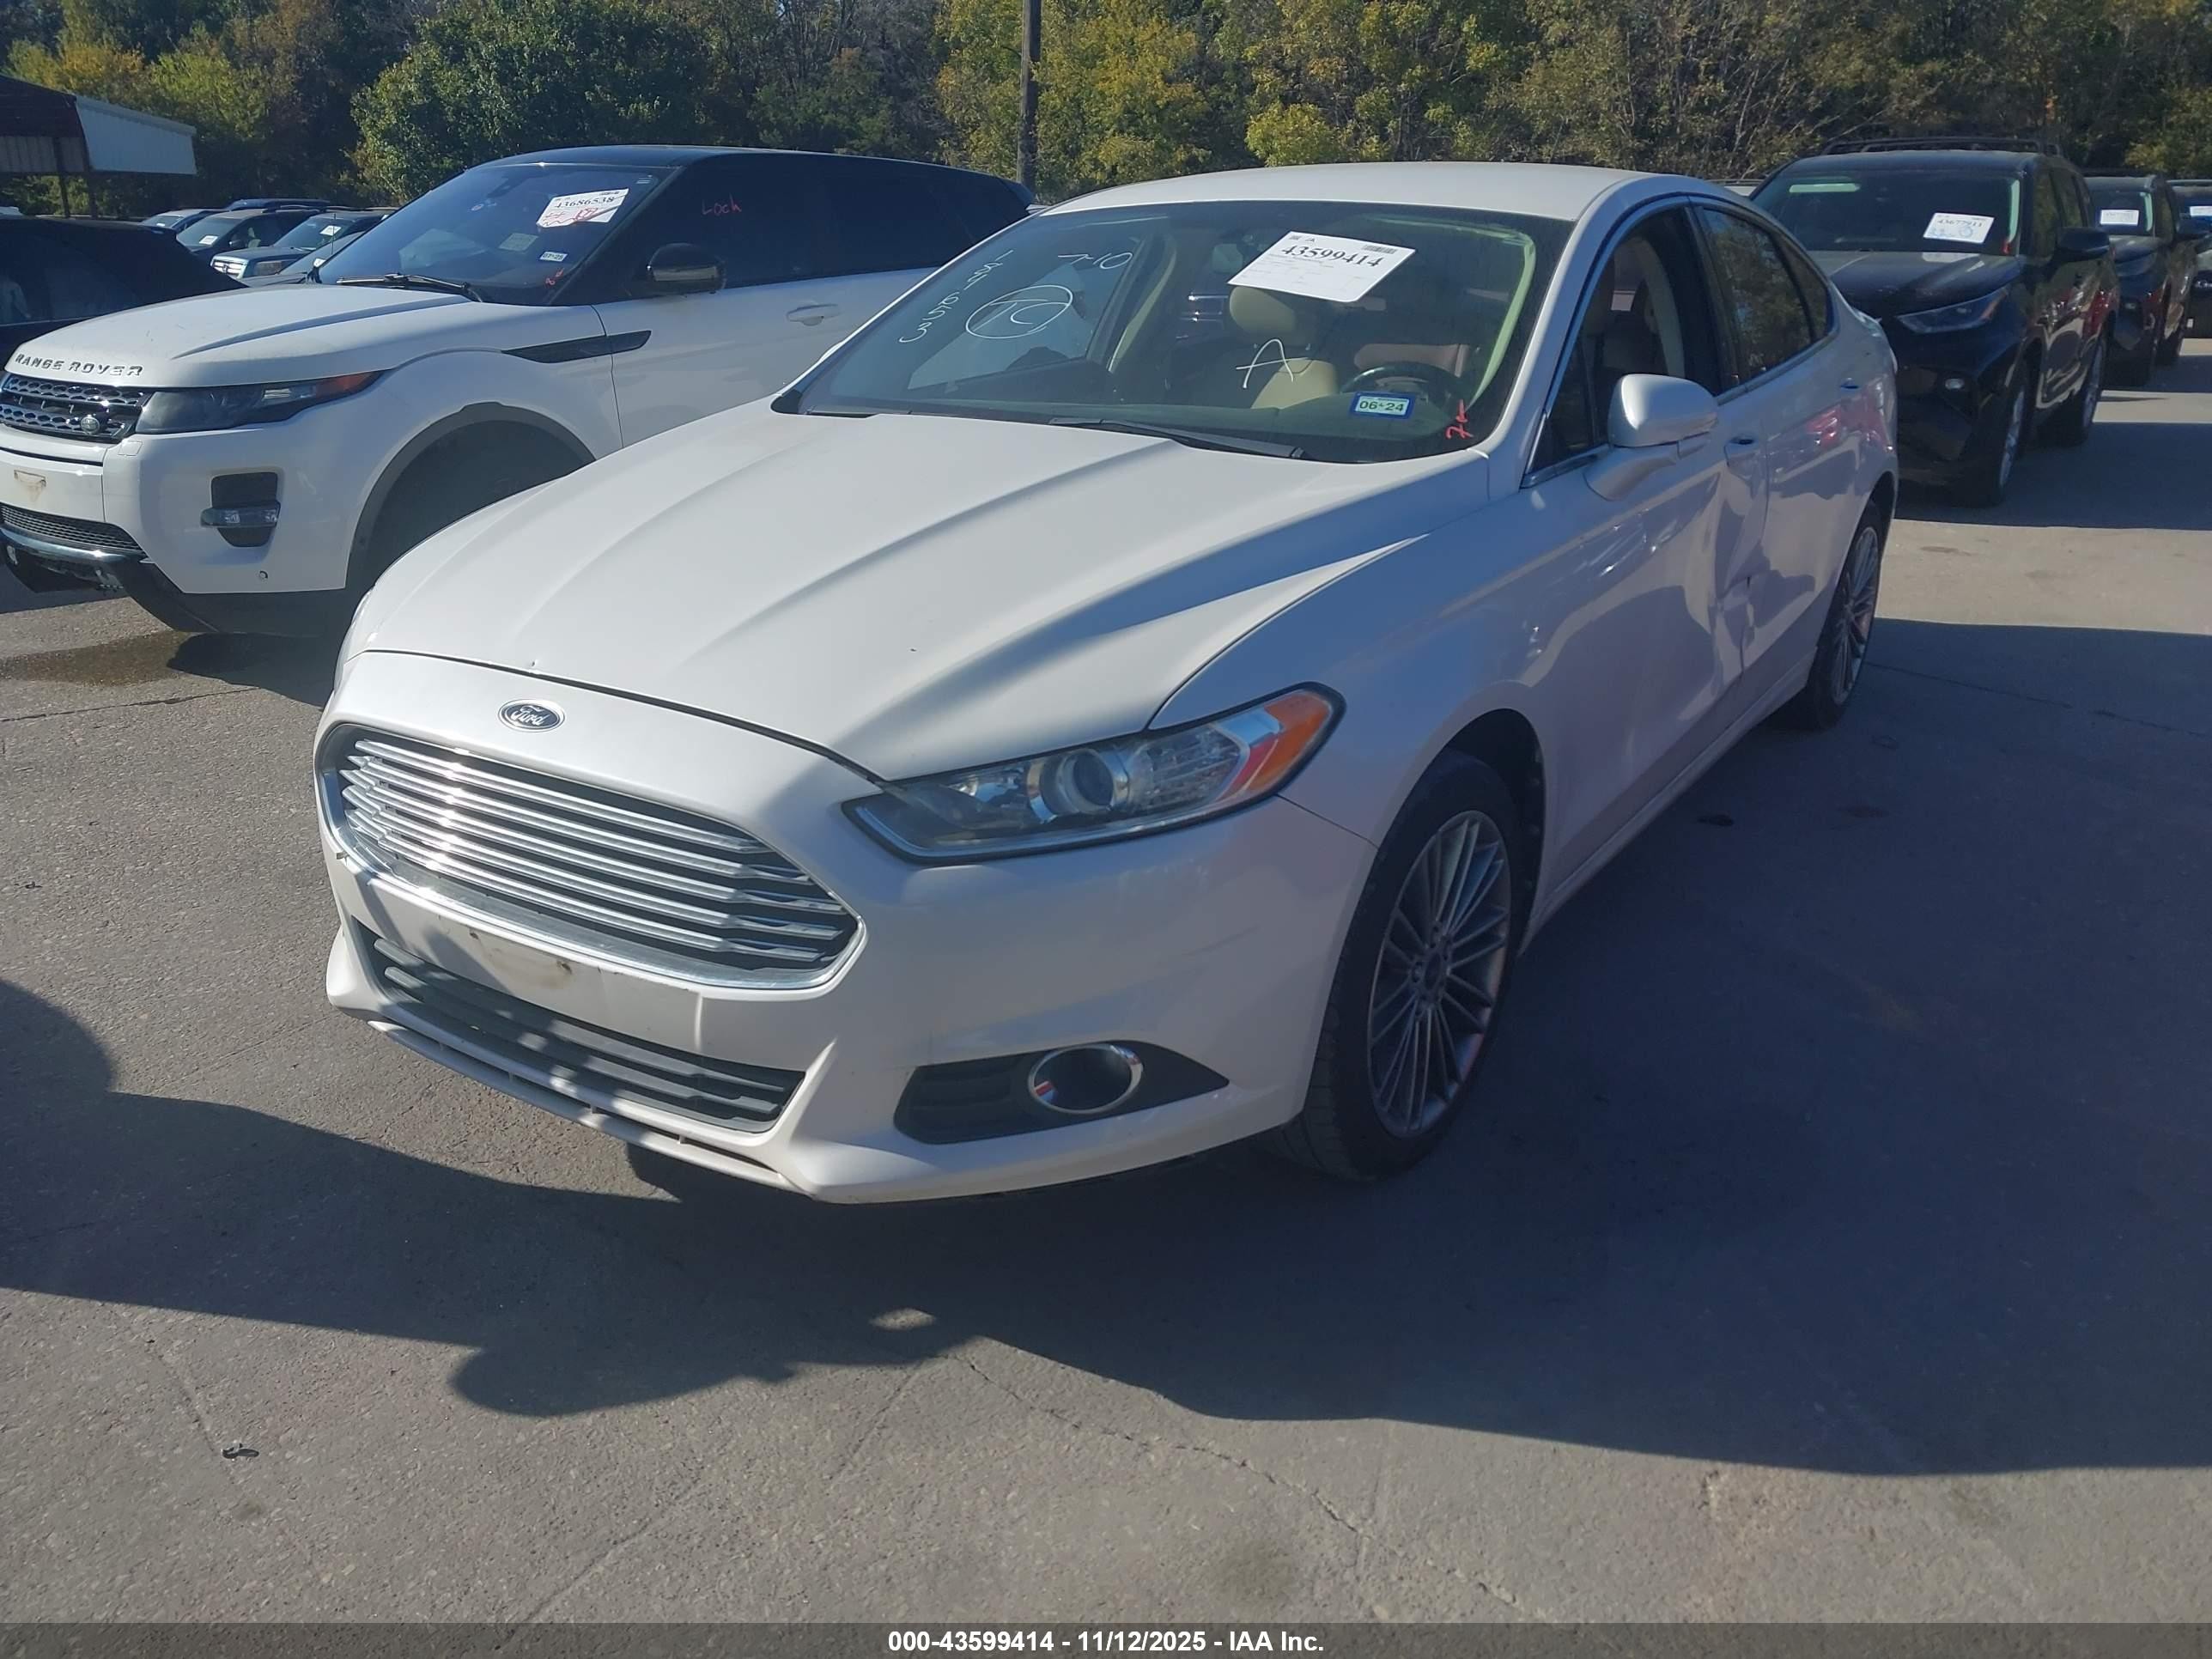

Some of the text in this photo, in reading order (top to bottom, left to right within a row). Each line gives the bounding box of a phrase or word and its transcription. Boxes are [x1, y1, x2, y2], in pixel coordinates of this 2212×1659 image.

[555, 197, 615, 208] 43686538
[1282, 245, 1384, 267] 43599414
[15, 353, 143, 376] RANGE ROVER
[1236, 338, 1309, 389] A
[510, 705, 550, 726] Ford
